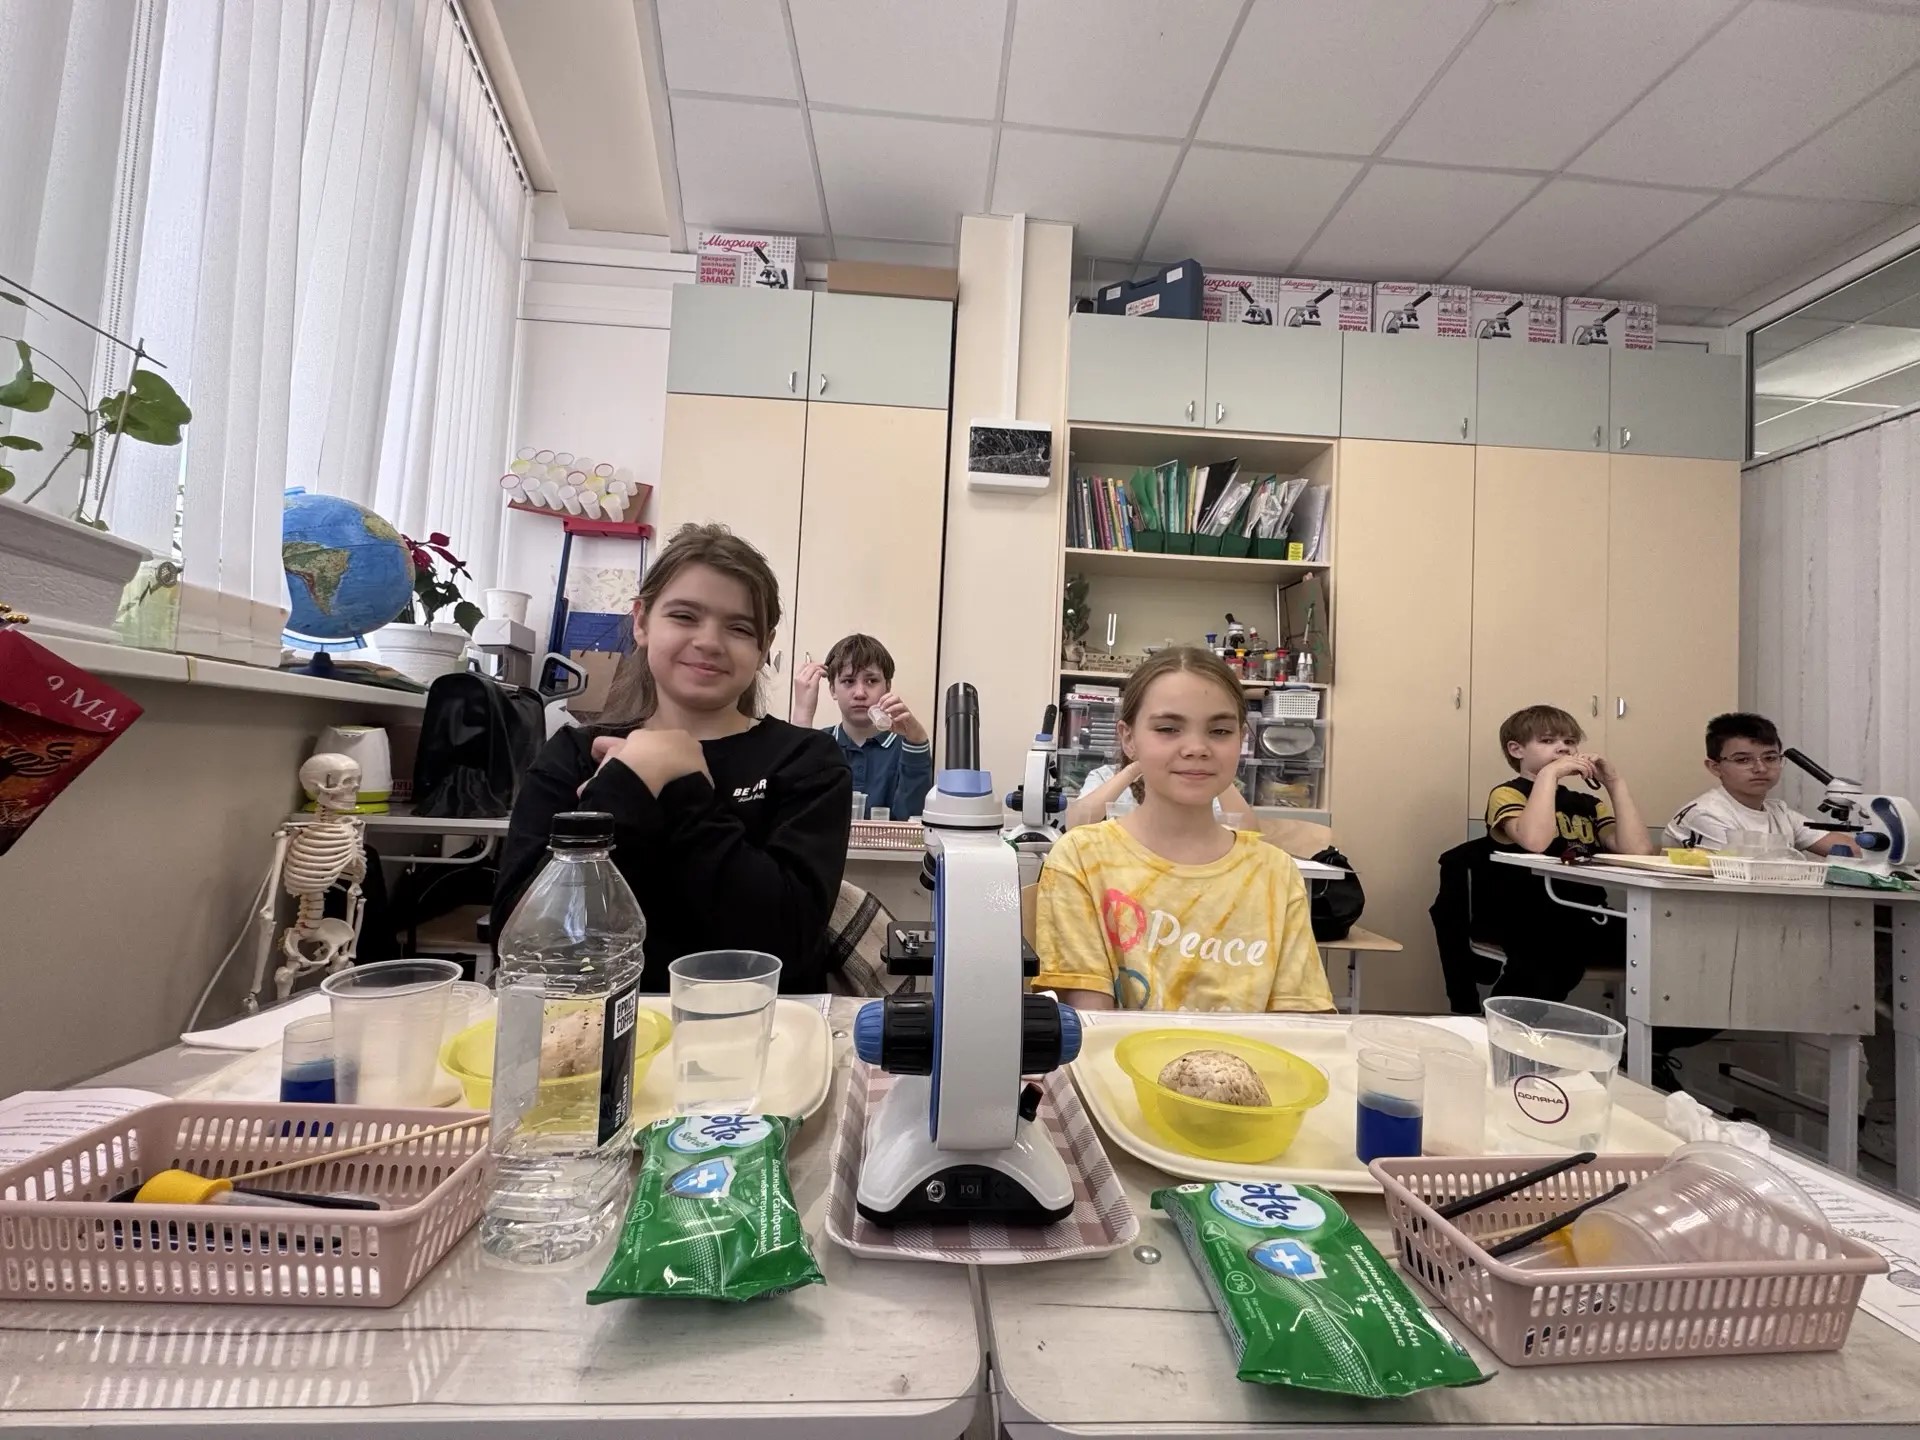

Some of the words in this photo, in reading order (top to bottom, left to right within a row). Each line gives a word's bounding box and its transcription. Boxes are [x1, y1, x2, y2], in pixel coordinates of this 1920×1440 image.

[699, 276, 735, 285] SMART
[700, 267, 735, 276] ЭВРИКА
[1148, 909, 1268, 967] Peace
[1517, 1091, 1564, 1105] ДОЛЯНА
[772, 1158, 781, 1196] Влажные
[759, 1168, 769, 1253] антибактериальные
[770, 1197, 783, 1251] салфетки
[1231, 1274, 1249, 1291] 0%
[1344, 1253, 1406, 1348] антибактериальные
[1351, 1244, 1386, 1287] Влажные
[1382, 1288, 1421, 1347] салфетки
